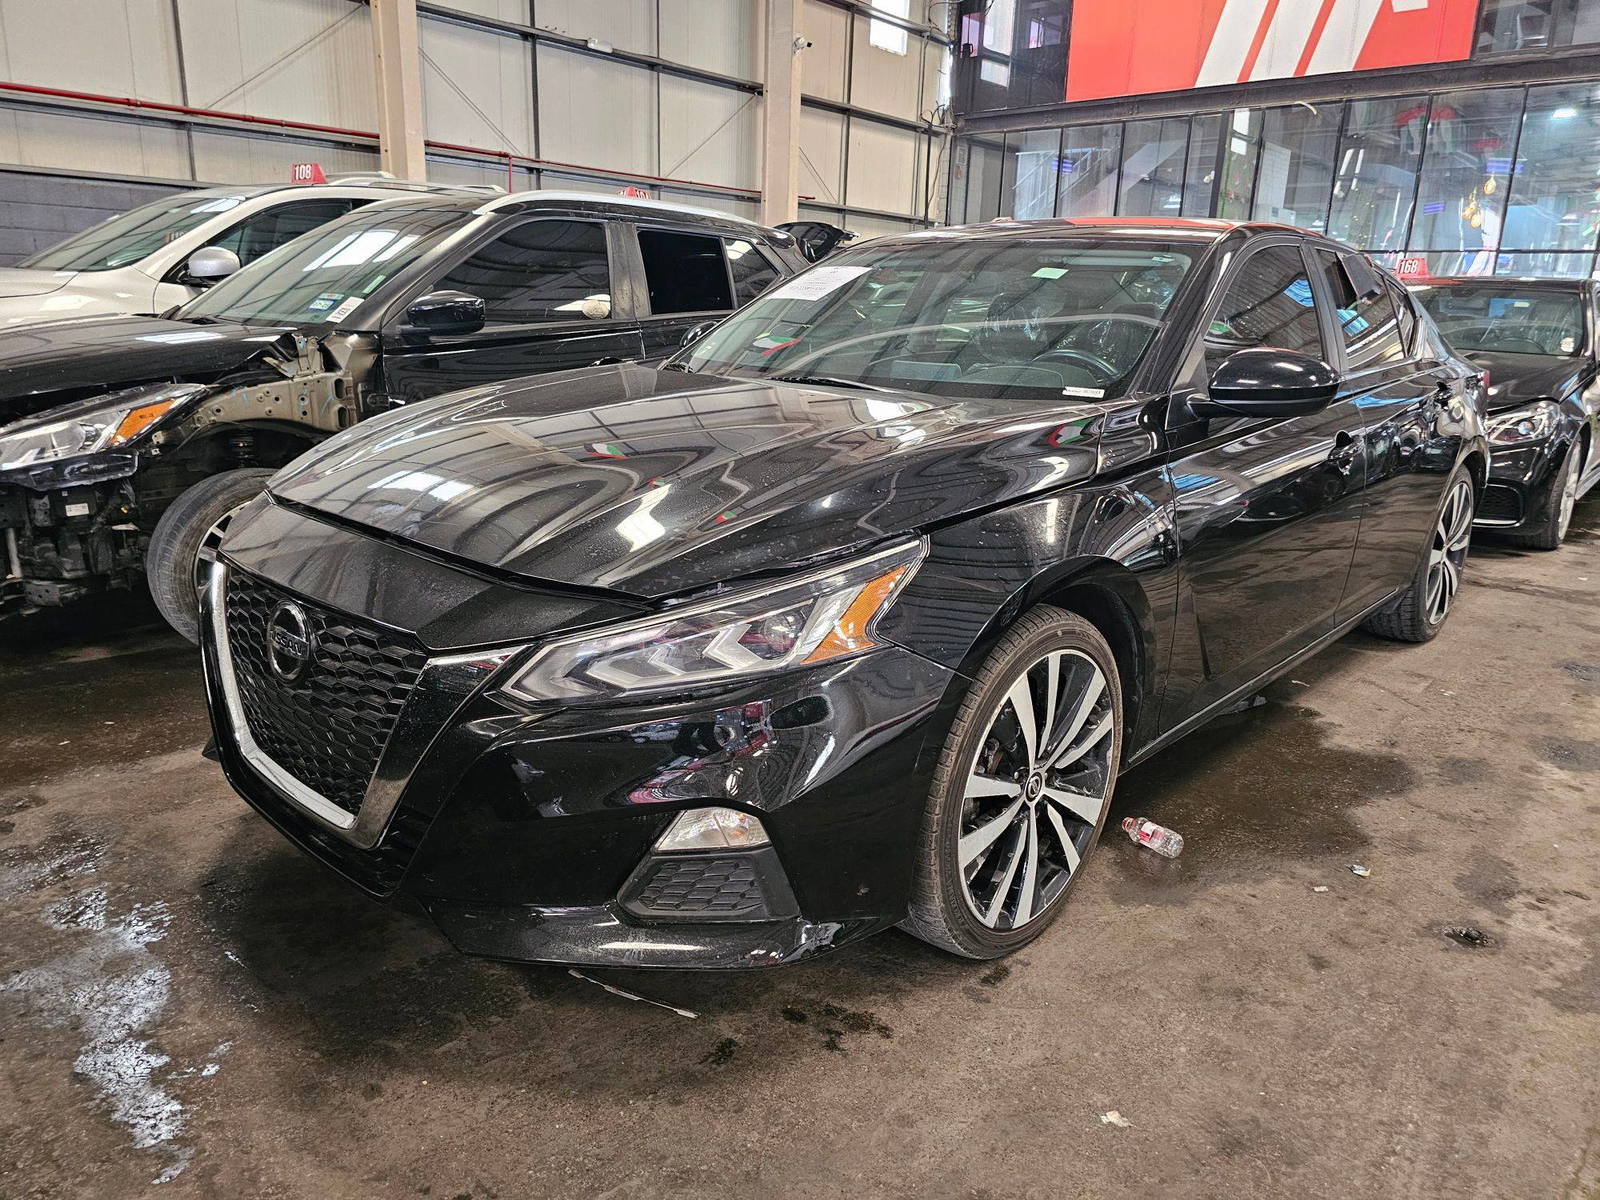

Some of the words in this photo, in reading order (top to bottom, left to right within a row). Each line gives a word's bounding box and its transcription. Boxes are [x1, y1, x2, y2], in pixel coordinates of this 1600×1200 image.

[295, 164, 312, 180] 108
[1400, 259, 1418, 274] 168
[269, 629, 305, 657] SSAN
